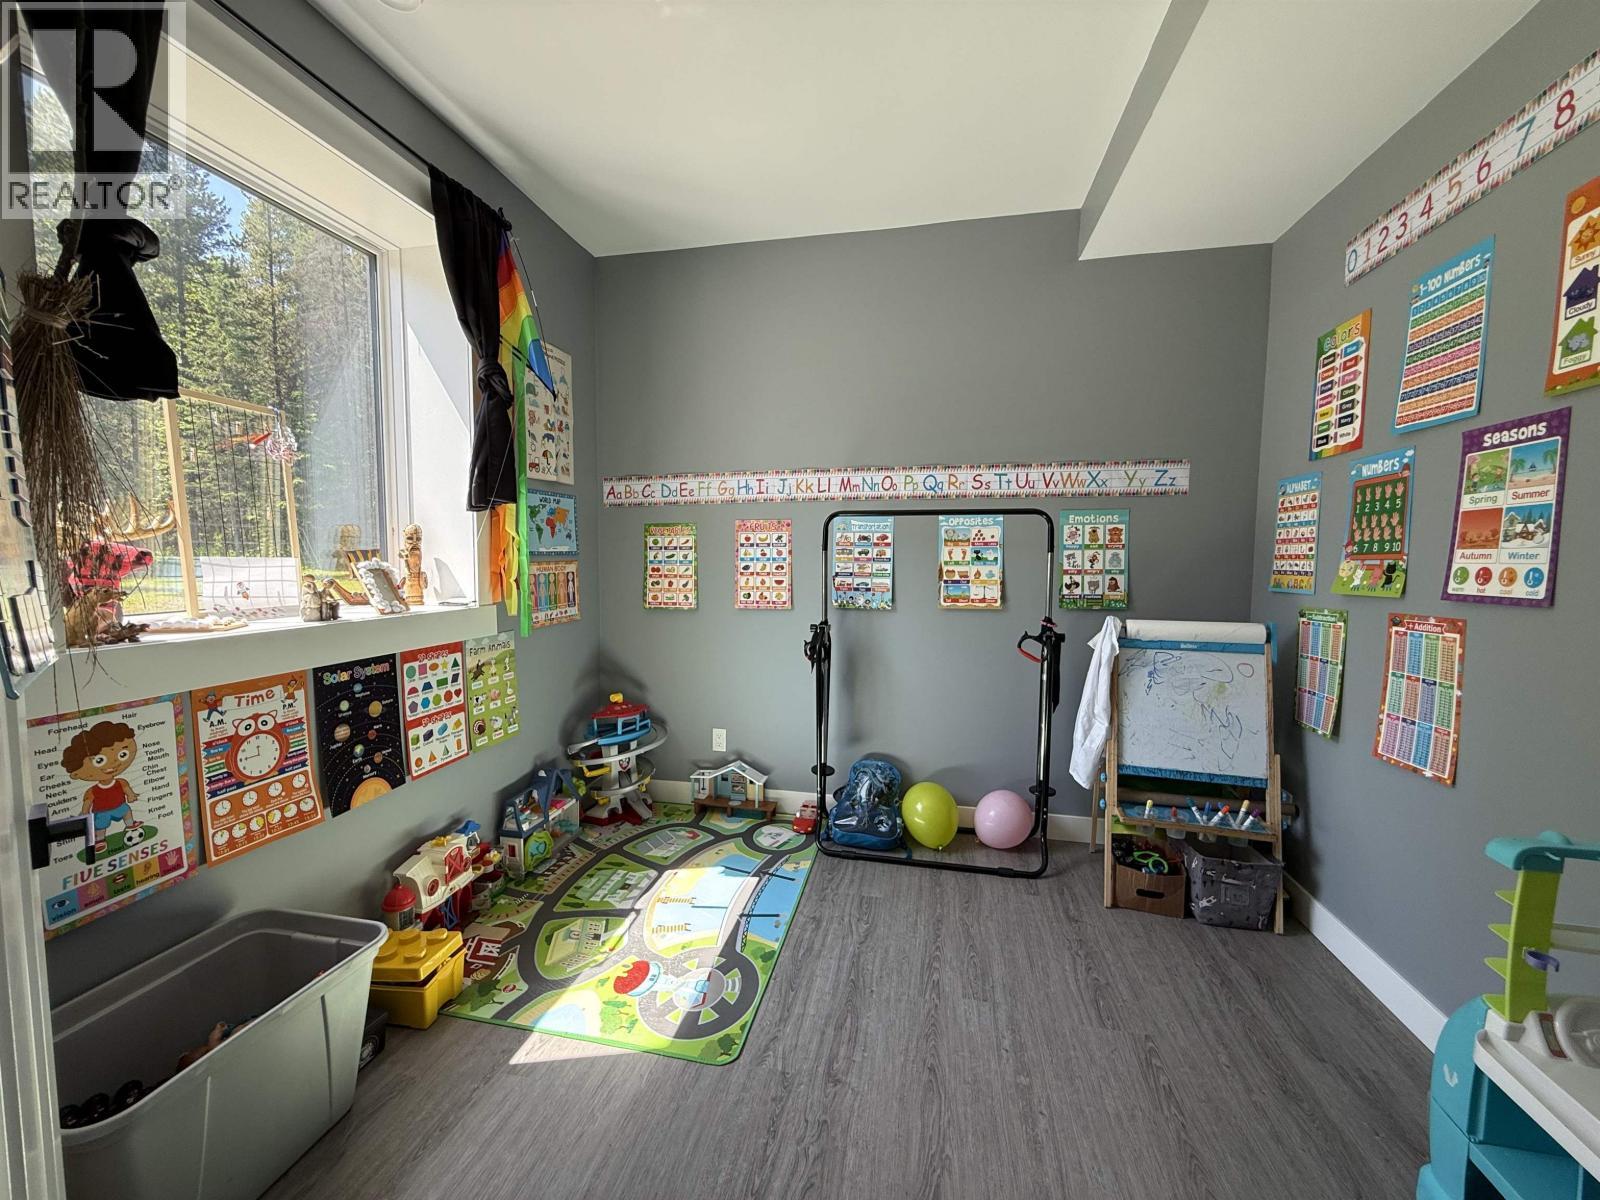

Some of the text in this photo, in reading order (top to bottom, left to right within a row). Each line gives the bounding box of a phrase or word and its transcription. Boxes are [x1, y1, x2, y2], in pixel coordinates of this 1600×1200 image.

[1346, 88, 1576, 274] 0 1 2 3 4 5 6 7 8
[1574, 248, 1596, 264] Sunny
[1568, 301, 1593, 315] Cloudy
[1564, 352, 1587, 365] Foggy
[1468, 489, 1550, 506] Spring Summer
[1068, 514, 1120, 524] Emotions
[1460, 551, 1540, 560] Autumn Winter
[1476, 586, 1486, 594] hot
[1414, 622, 1442, 633] Addition
[469, 640, 511, 657] Farm Animals
[322, 662, 390, 685] Solar System
[234, 689, 276, 708] Time
[282, 702, 296, 710] P.M.
[122, 712, 137, 720] Hair
[137, 721, 166, 731] Eyebrow
[210, 718, 228, 728] A.M.
[48, 722, 88, 736] Forehead
[142, 741, 160, 749] Nose
[34, 746, 57, 756] Head
[145, 748, 164, 757] Tooth
[148, 753, 170, 762] Mouth
[37, 760, 59, 770] Eyes
[142, 764, 158, 772] Chin
[146, 766, 167, 776] Chest
[40, 774, 55, 782] Ear
[144, 776, 166, 785] Elbow
[38, 780, 72, 793] Cheeks
[152, 782, 170, 792] Hand
[46, 790, 67, 800] Neck
[147, 791, 173, 803] Fingers
[48, 796, 78, 808] oulders
[51, 806, 70, 817] Arm
[148, 804, 166, 814] Knee
[158, 810, 174, 820] Foot
[53, 854, 73, 864] Toes
[62, 839, 168, 890] FIVE SENSES
[52, 908, 77, 922] vision
[135, 872, 160, 886] hearing
